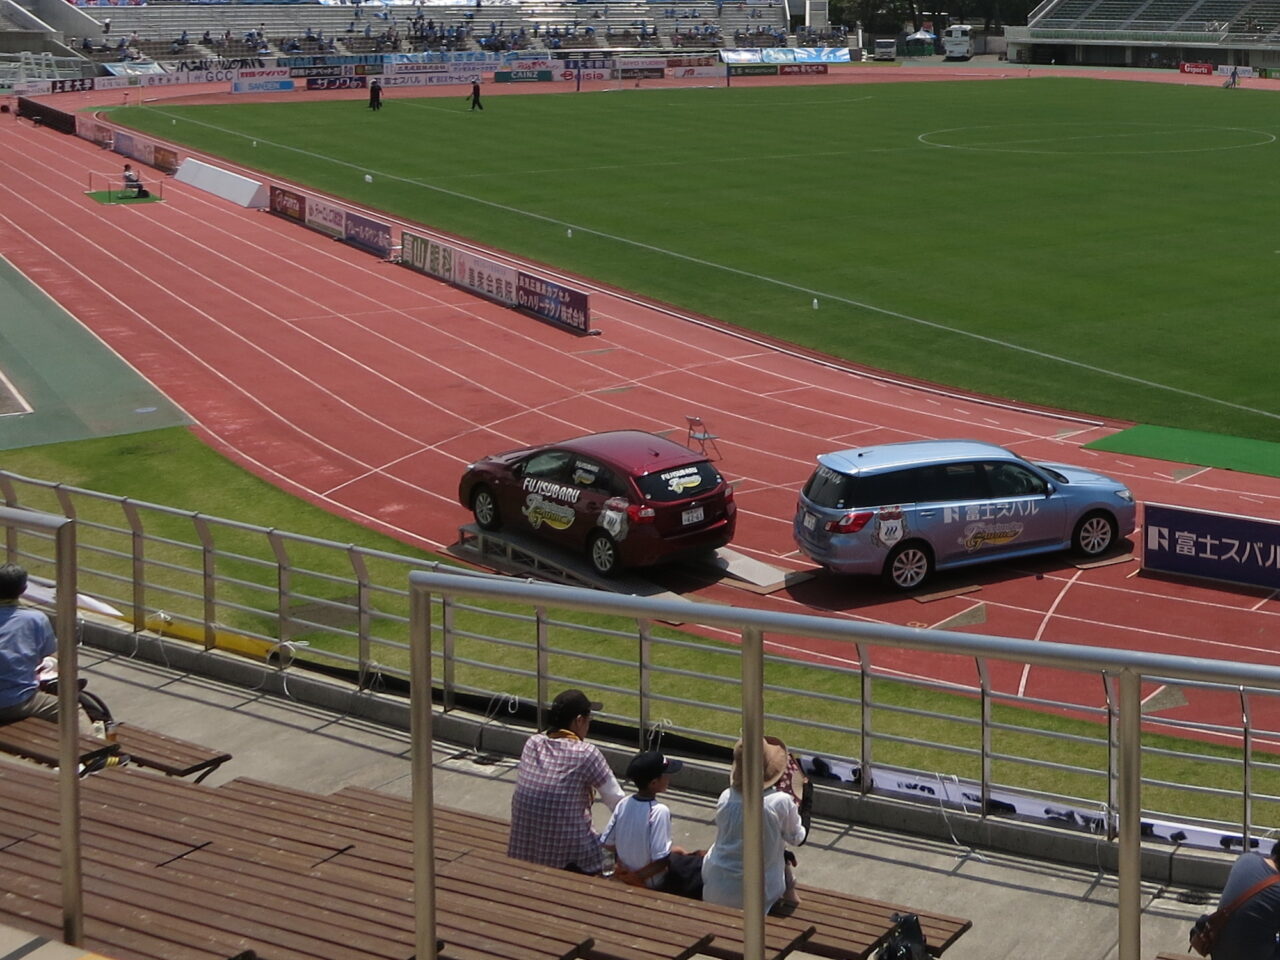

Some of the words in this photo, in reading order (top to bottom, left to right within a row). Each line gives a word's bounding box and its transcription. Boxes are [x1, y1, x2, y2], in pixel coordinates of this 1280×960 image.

[205, 70, 234, 82] GCC
[384, 75, 421, 85] 富士スバル
[511, 70, 538, 78] CAINZ
[53, 77, 94, 92] 上武大学
[248, 80, 281, 90] SANDEN
[660, 466, 699, 481] FUJISUBARU
[522, 477, 581, 504] FUJISUBARU
[965, 500, 1040, 522] 富士スバル
